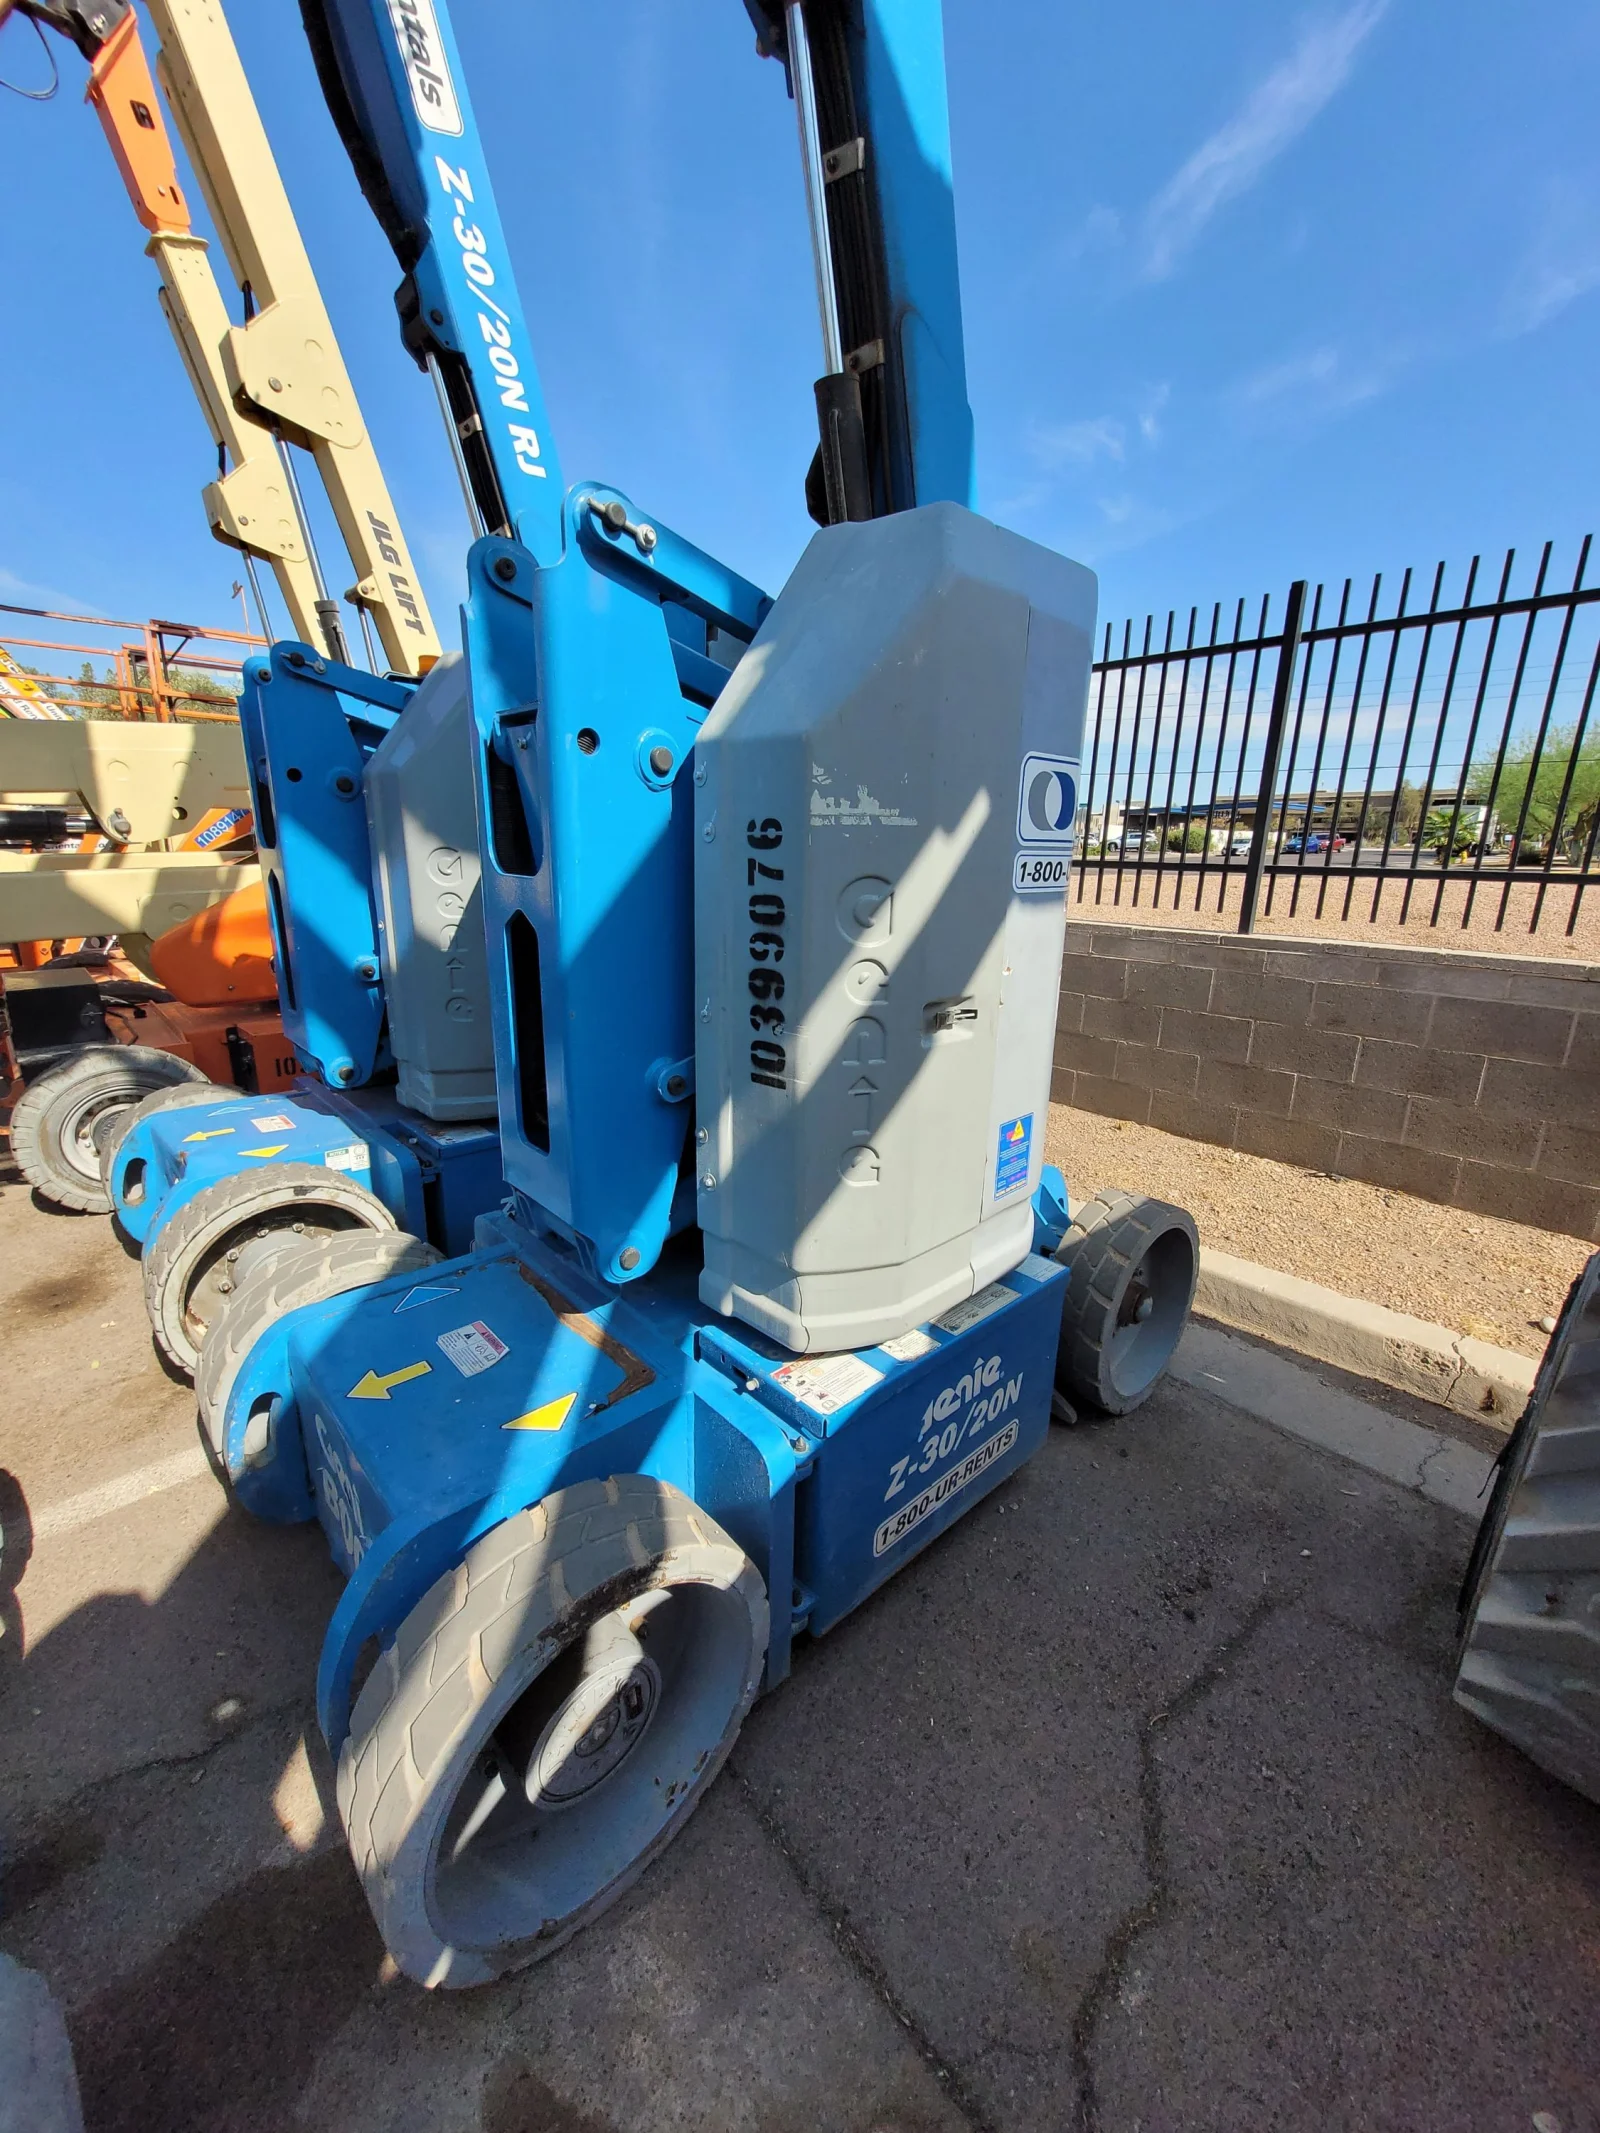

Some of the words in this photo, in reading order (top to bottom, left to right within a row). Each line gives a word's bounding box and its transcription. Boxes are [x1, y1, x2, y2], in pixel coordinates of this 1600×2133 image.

[435, 155, 529, 412] Z-30/20N
[508, 423, 546, 479] RJ
[366, 510, 402, 567] JLG
[388, 572, 426, 636] LIFT
[746, 817, 787, 1090] 10399076
[881, 1426, 1015, 1547] 1-800-UR-RENTS
[884, 1372, 1024, 1503] Z-30/20N
